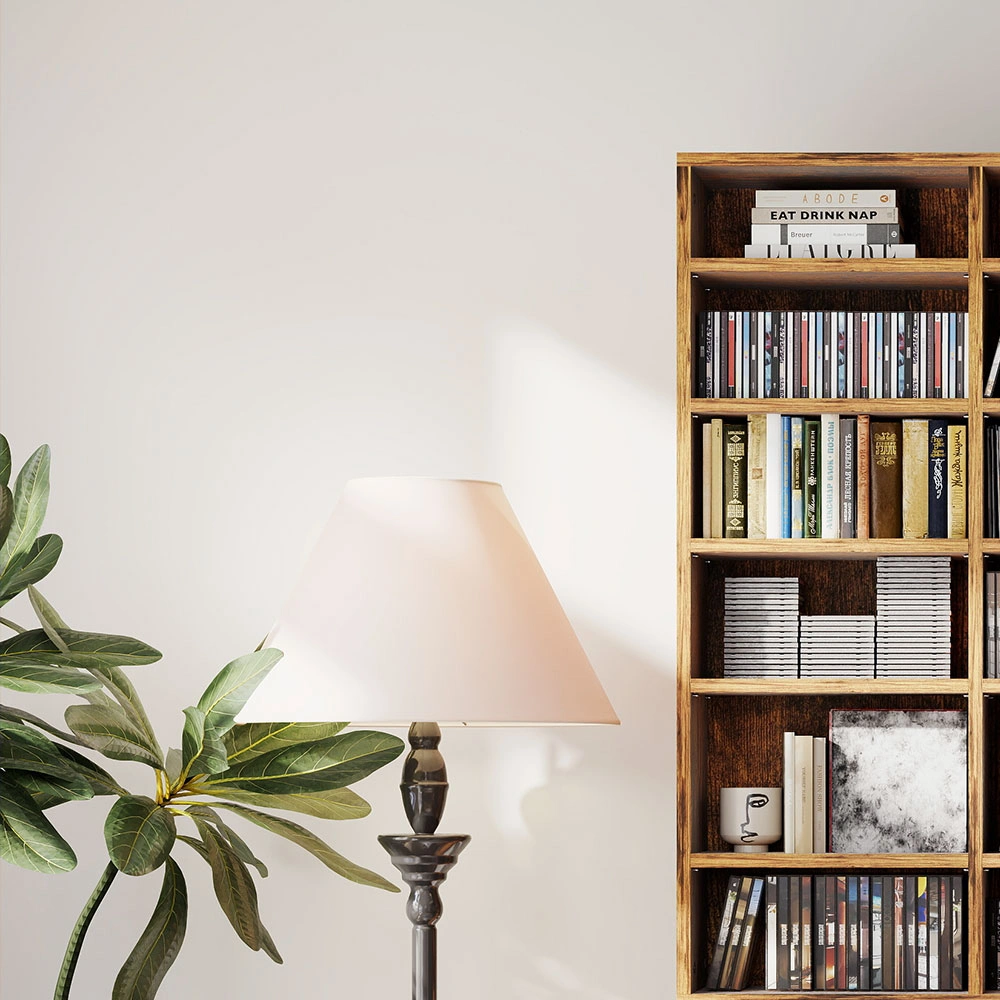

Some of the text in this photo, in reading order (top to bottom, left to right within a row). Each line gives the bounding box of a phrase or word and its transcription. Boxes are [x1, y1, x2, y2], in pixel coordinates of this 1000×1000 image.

[802, 193, 859, 204] ABODE
[770, 211, 878, 220] EAT DRINK NAP
[790, 231, 813, 239] Breuer
[827, 421, 835, 454] ПОЭМЫ
[826, 459, 834, 481] БЛОК
